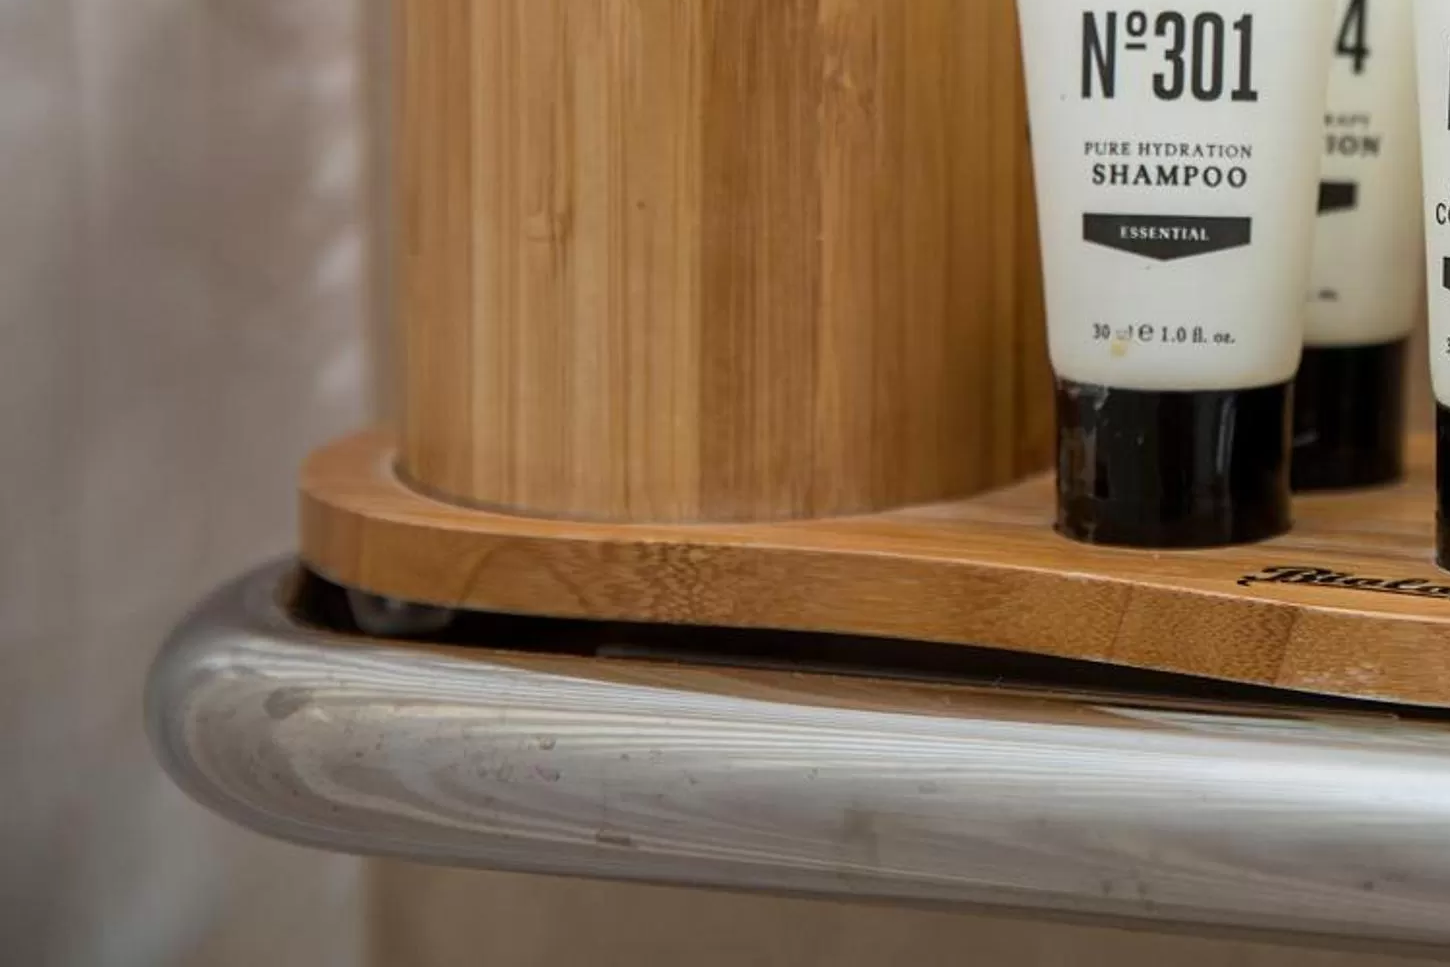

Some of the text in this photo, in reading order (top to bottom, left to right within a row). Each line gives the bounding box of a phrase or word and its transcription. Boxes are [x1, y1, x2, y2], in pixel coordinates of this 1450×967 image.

[1084, 141, 1253, 159] PURE HYDRATION
[1092, 164, 1248, 188] SHAMPOO
[1120, 226, 1209, 241] ESSENTIAL
[1093, 322, 1111, 340] 30
